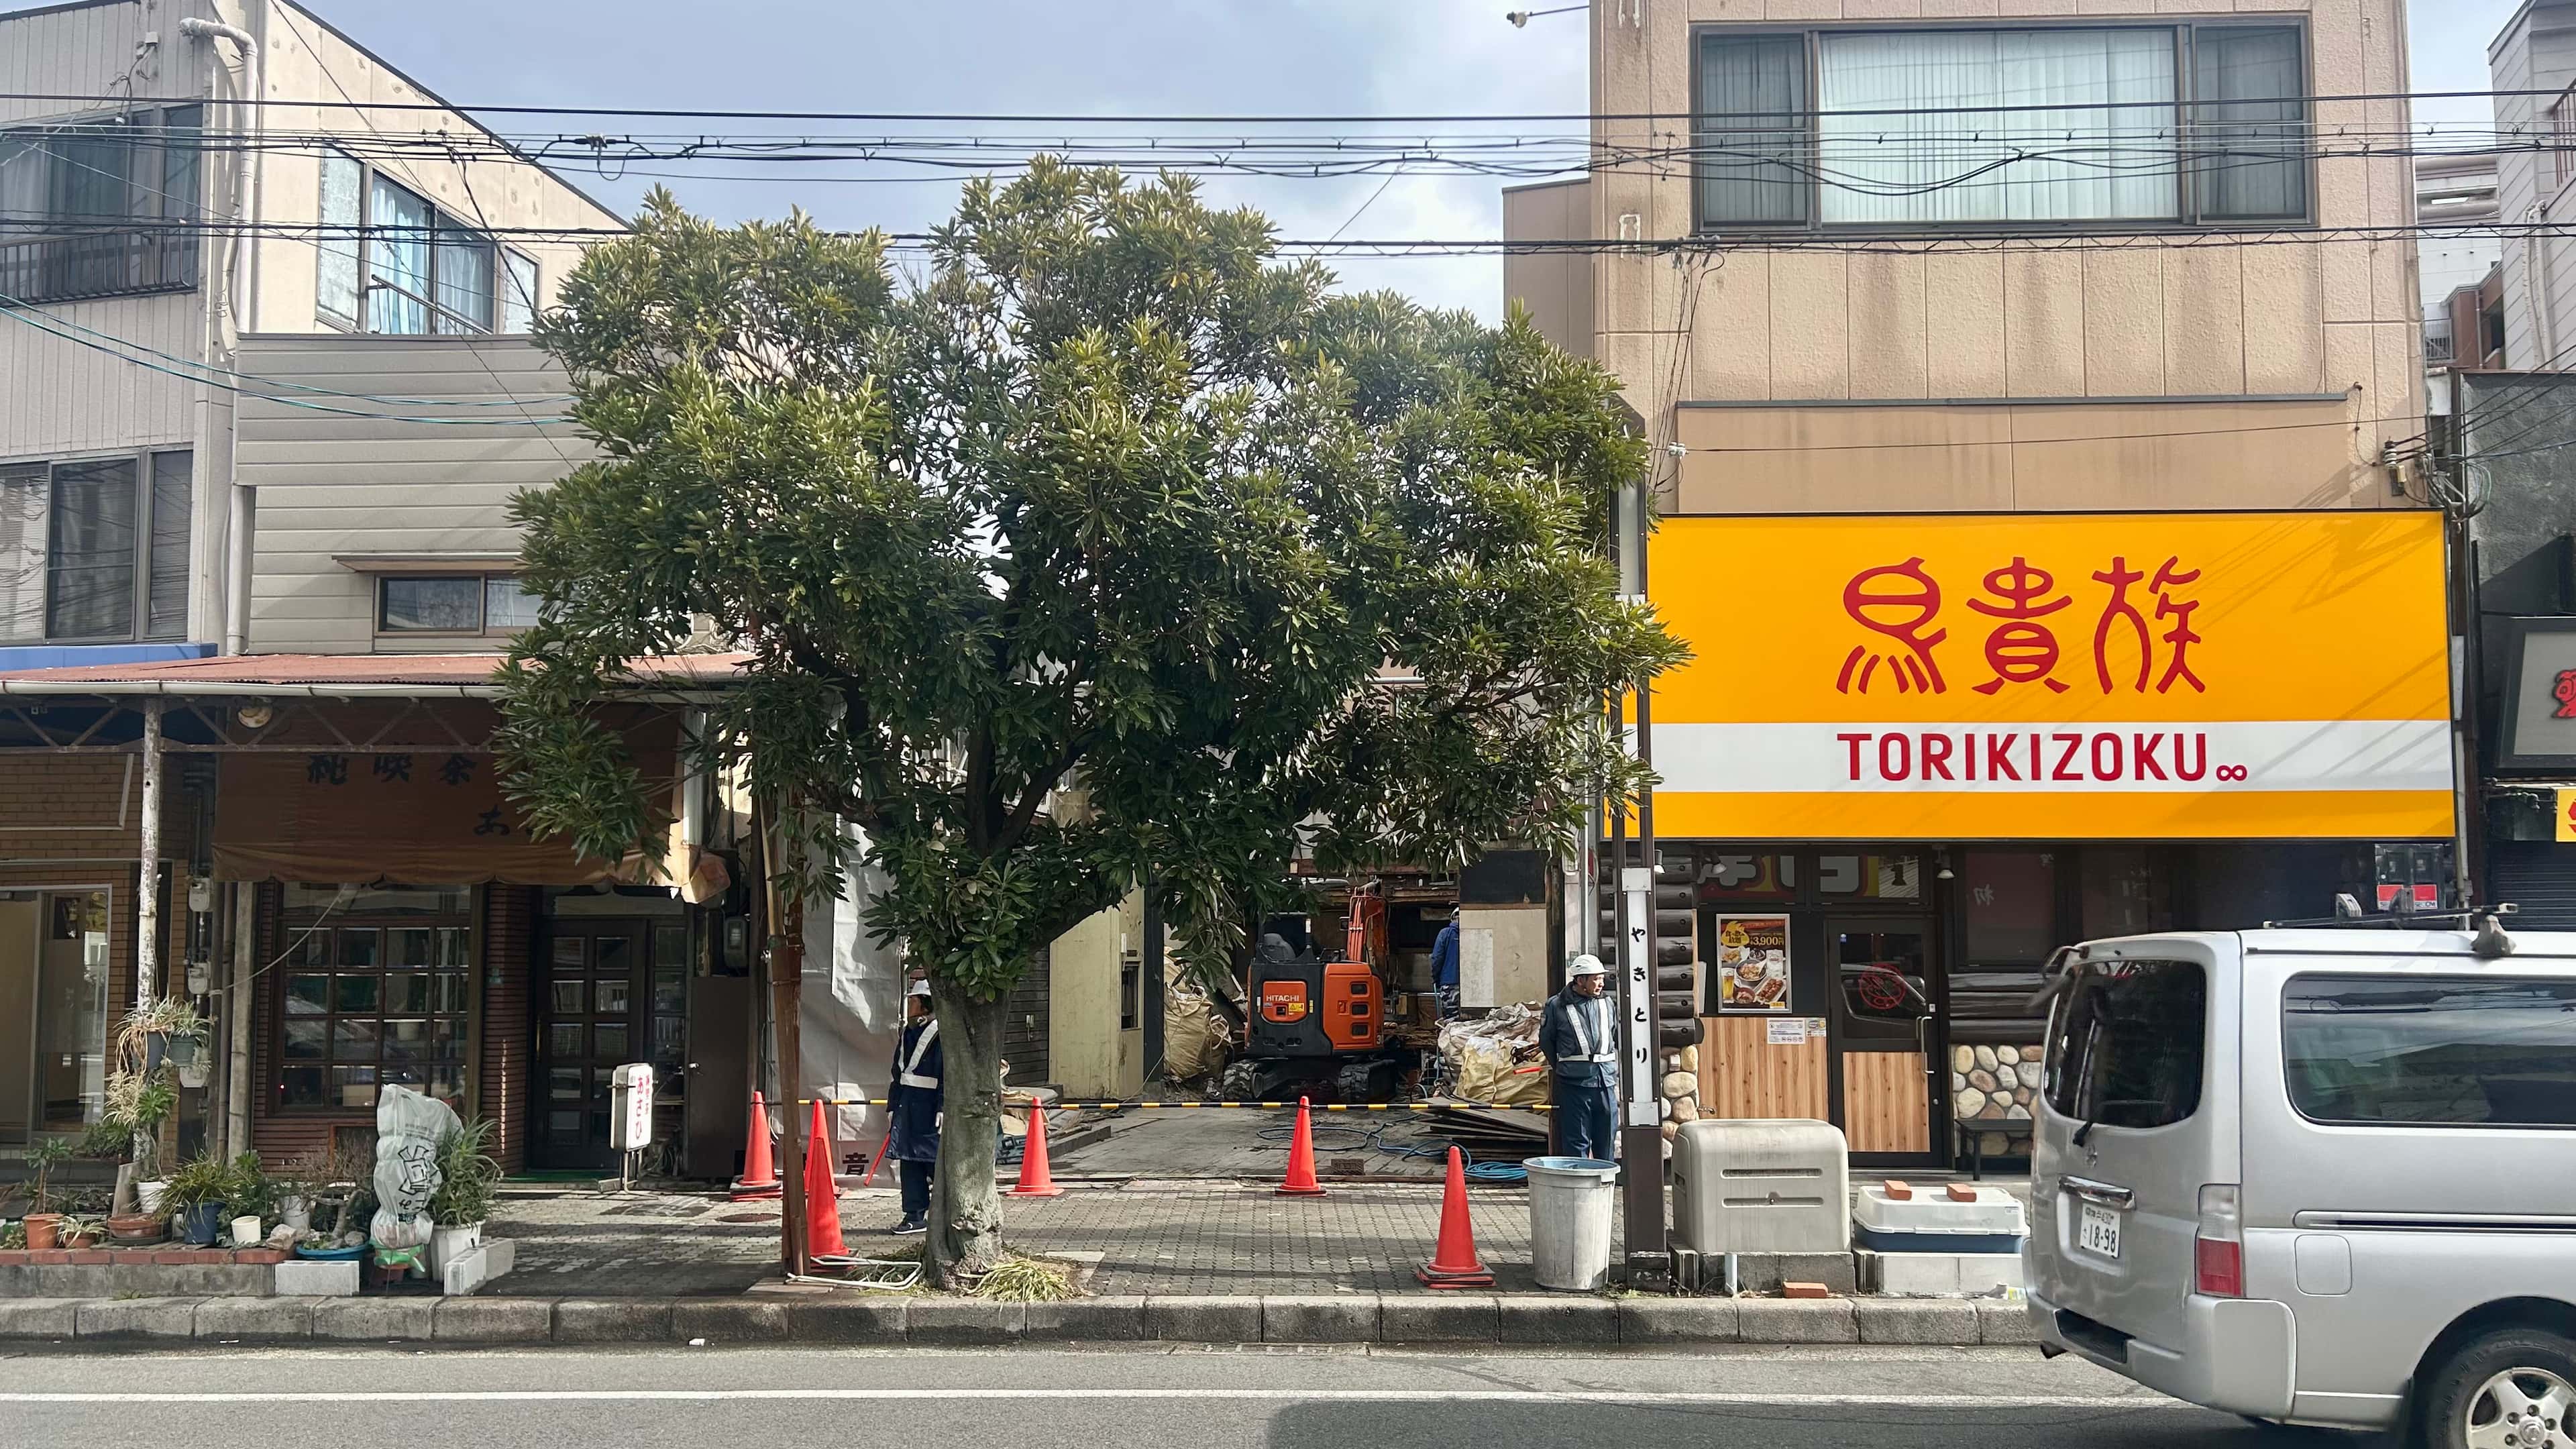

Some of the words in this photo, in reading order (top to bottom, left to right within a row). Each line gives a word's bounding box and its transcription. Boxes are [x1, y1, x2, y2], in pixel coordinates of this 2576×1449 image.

[1835, 555, 2206, 695] 鳥貴族
[1837, 732, 2207, 782] TORIKIZOKU
[1631, 926, 1647, 1063] やきとり
